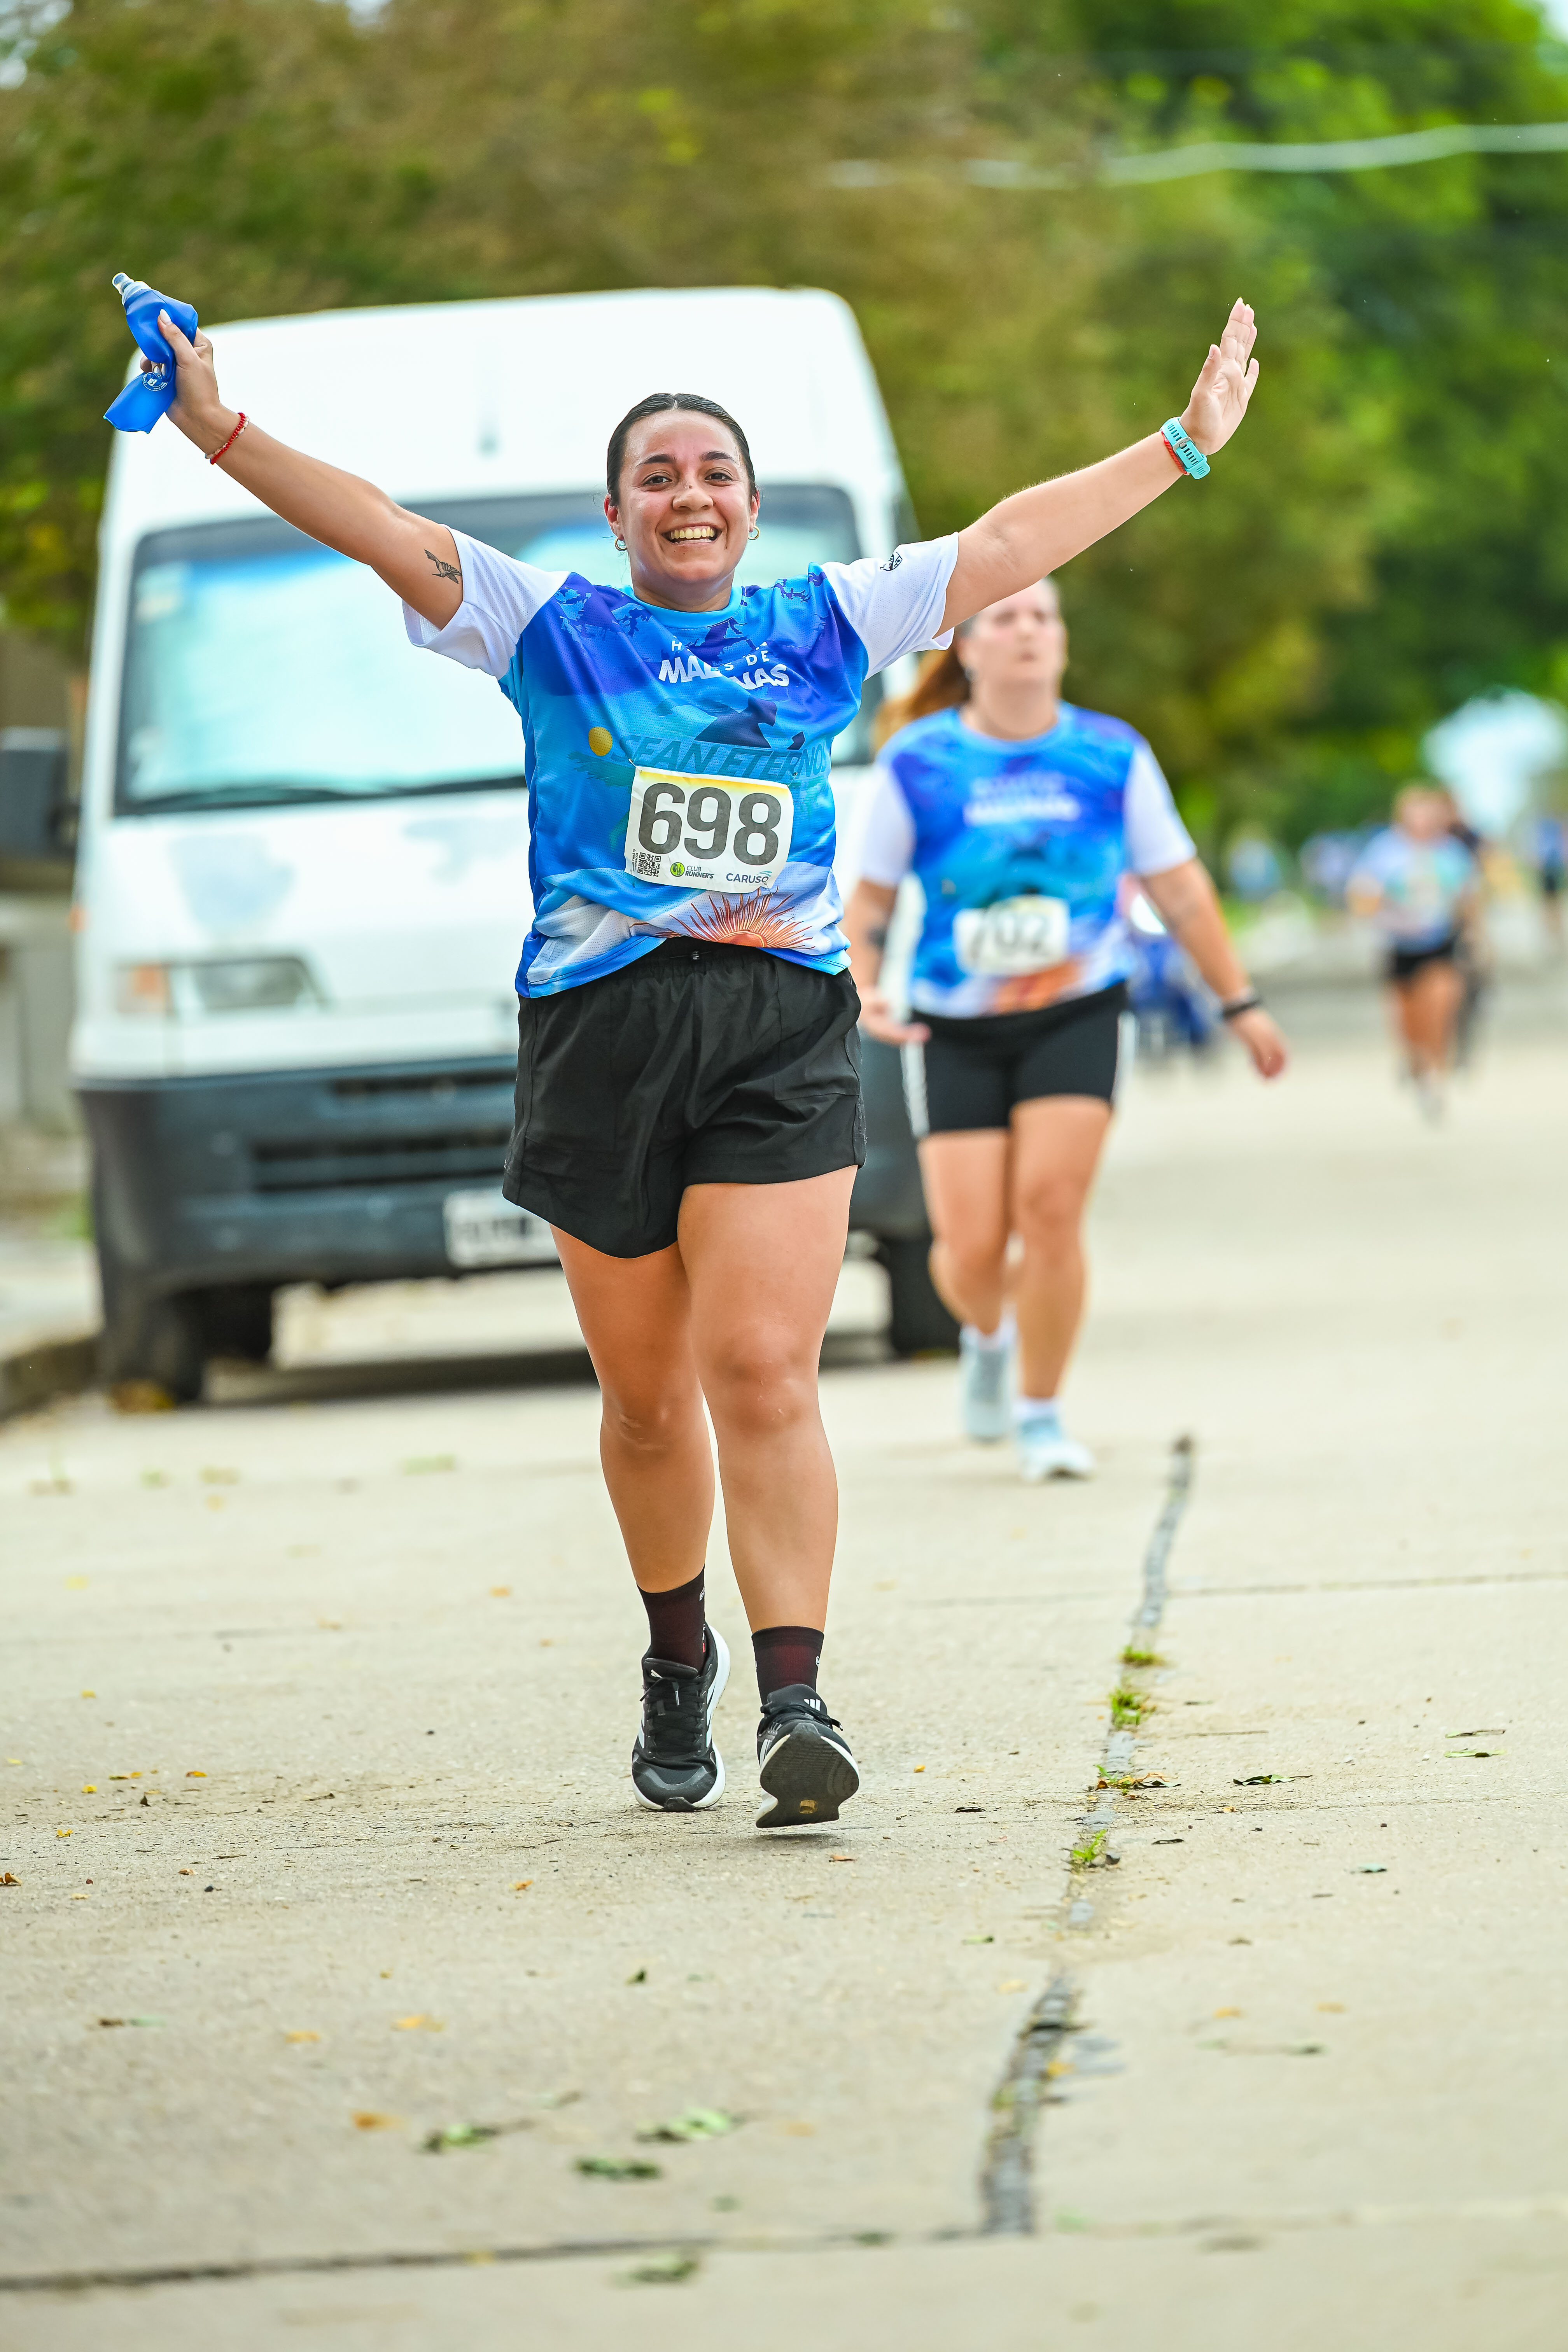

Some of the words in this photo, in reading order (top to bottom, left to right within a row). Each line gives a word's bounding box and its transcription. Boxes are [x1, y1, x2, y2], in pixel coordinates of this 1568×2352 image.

[746, 651, 770, 666] DE
[639, 783, 781, 865] 698
[726, 873, 769, 883] CARUSO
